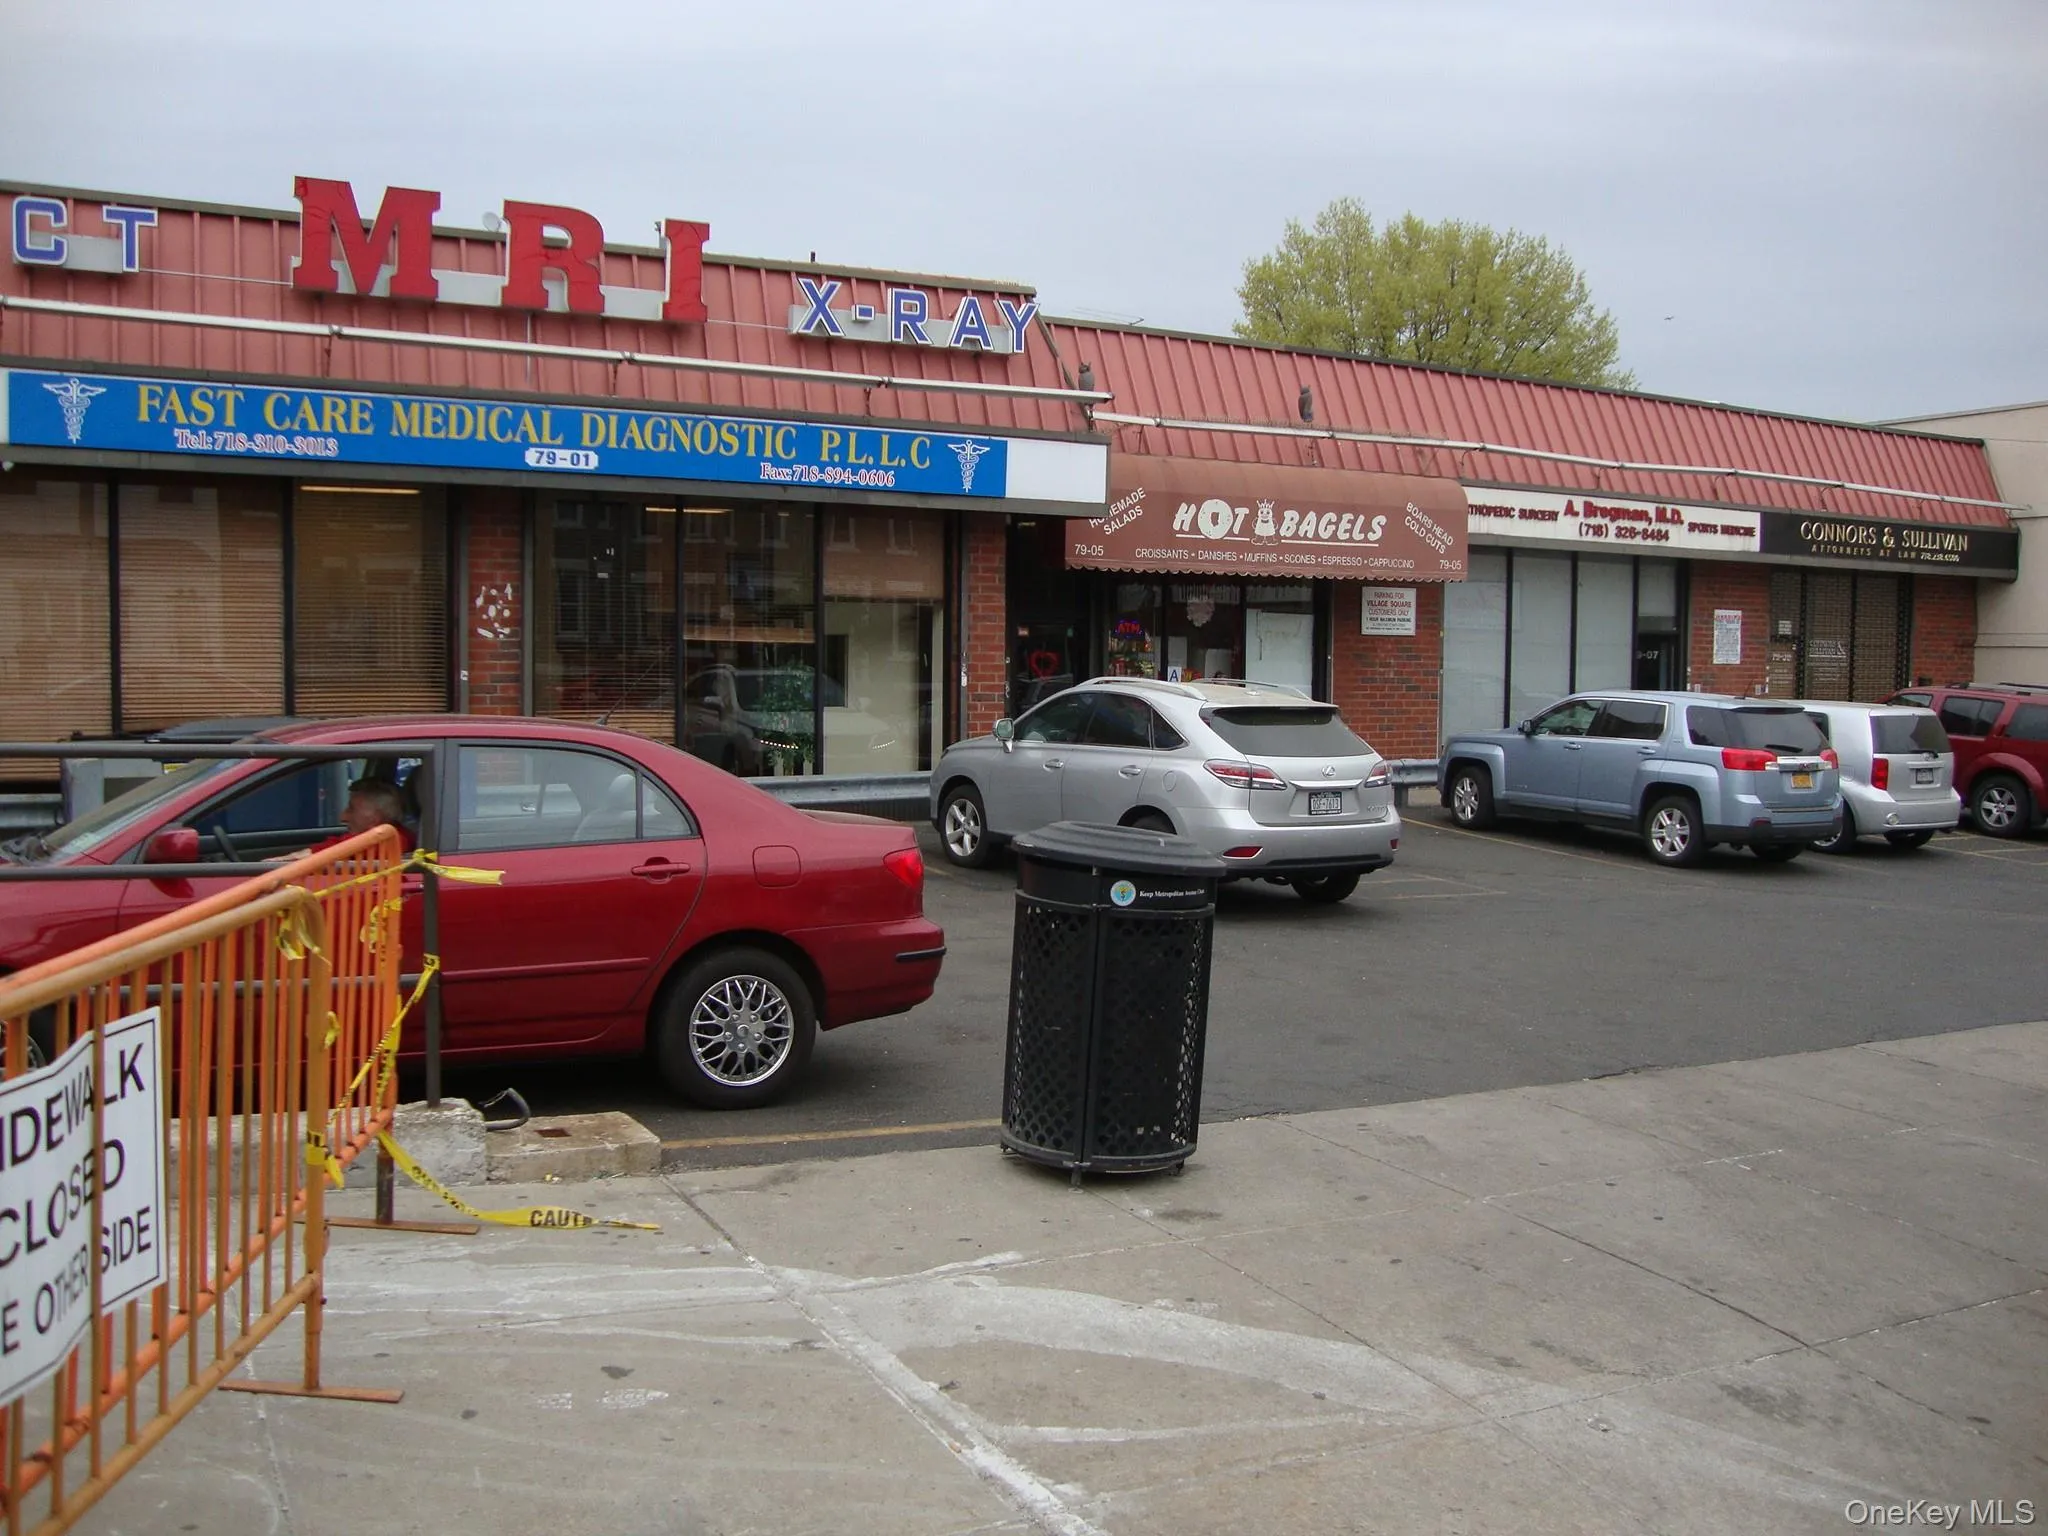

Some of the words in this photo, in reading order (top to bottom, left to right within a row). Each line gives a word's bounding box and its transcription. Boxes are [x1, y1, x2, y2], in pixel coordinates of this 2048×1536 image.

[12, 196, 158, 272] CT
[291, 175, 711, 322] MRI
[797, 277, 1040, 354] X-RAY
[138, 384, 245, 427] FAST
[263, 392, 375, 437] CARE
[389, 400, 565, 446] MEDICAL
[581, 412, 798, 460] DIAGNOSTIC
[820, 428, 931, 470] P.L.L.C
[533, 449, 592, 468] 79-01
[1103, 505, 1144, 535] SALADS
[1172, 499, 1250, 540] HOT
[1278, 509, 1388, 541] BAGELS
[1406, 502, 1433, 529] BOARS
[1432, 523, 1454, 546] HEAD
[1468, 503, 1515, 518] THOPEDIC
[1519, 507, 1560, 521] SURGERY
[1404, 516, 1426, 537] COLD
[1425, 533, 1446, 554] CUTS
[1579, 521, 1608, 538] (718)
[1687, 521, 1719, 535] SPORTS
[1800, 521, 1877, 545] CONNORS
[1882, 526, 1896, 548] &
[1902, 529, 1968, 552] SULLIVAN
[1074, 544, 1104, 556] 79-05
[1135, 548, 1189, 560] CROISSANTS
[1198, 550, 1238, 562] DANISHES
[1244, 552, 1278, 563] MUFFINS
[1284, 553, 1316, 564] SCONES
[1322, 555, 1363, 567] ESPRESSO
[1368, 557, 1415, 569] CAPPUCCINO
[1811, 543, 1872, 557] ATTORNEYS
[1879, 548, 1891, 557] AT
[1439, 559, 1462, 570] 79-05
[1390, 600, 1412, 608] SQUARE
[1117, 622, 1140, 633] ATM
[1169, 669, 1179, 682] A
[0, 1042, 146, 1173] IDEWAK
[101, 1205, 152, 1274] SIDE
